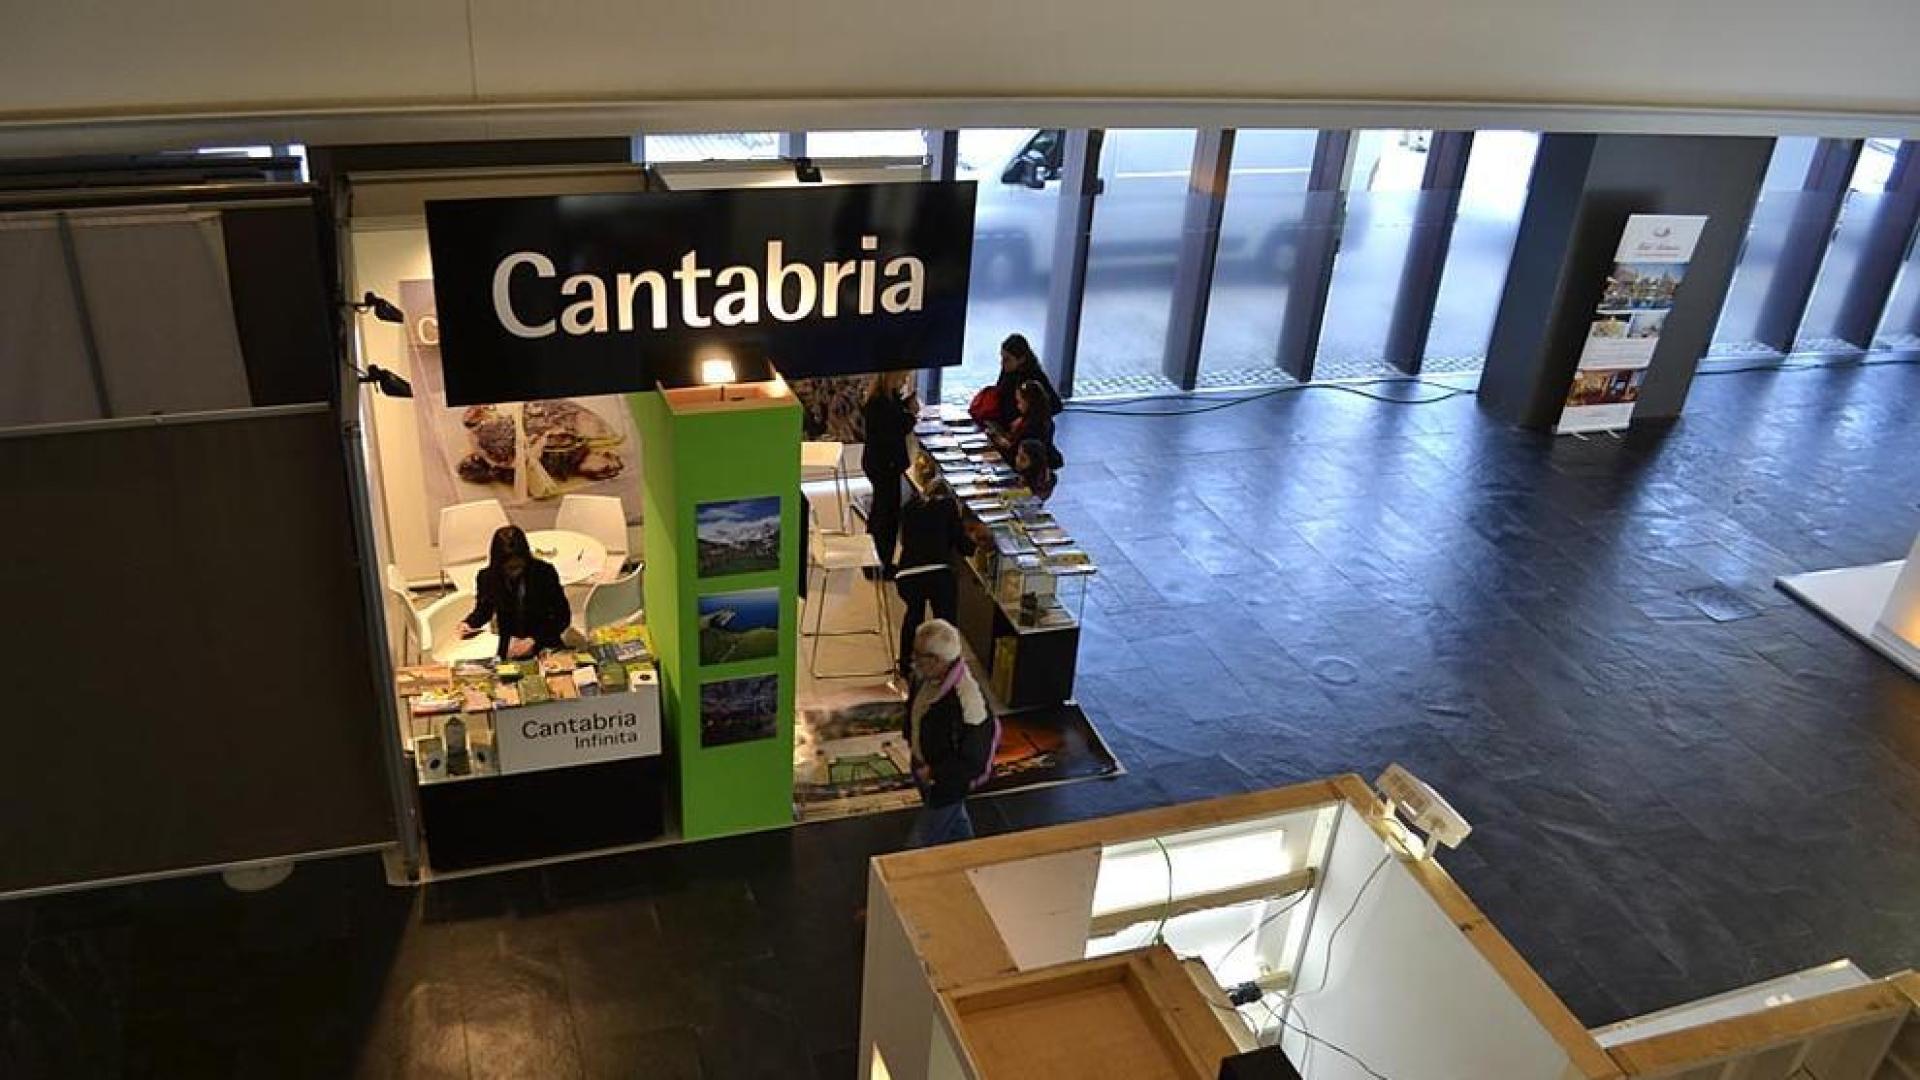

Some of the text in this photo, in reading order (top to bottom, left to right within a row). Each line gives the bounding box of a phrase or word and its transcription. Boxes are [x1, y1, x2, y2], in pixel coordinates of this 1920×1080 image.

[492, 236, 925, 339] Cantabria
[521, 710, 637, 740] Cantabria
[575, 731, 637, 749] Infinita
